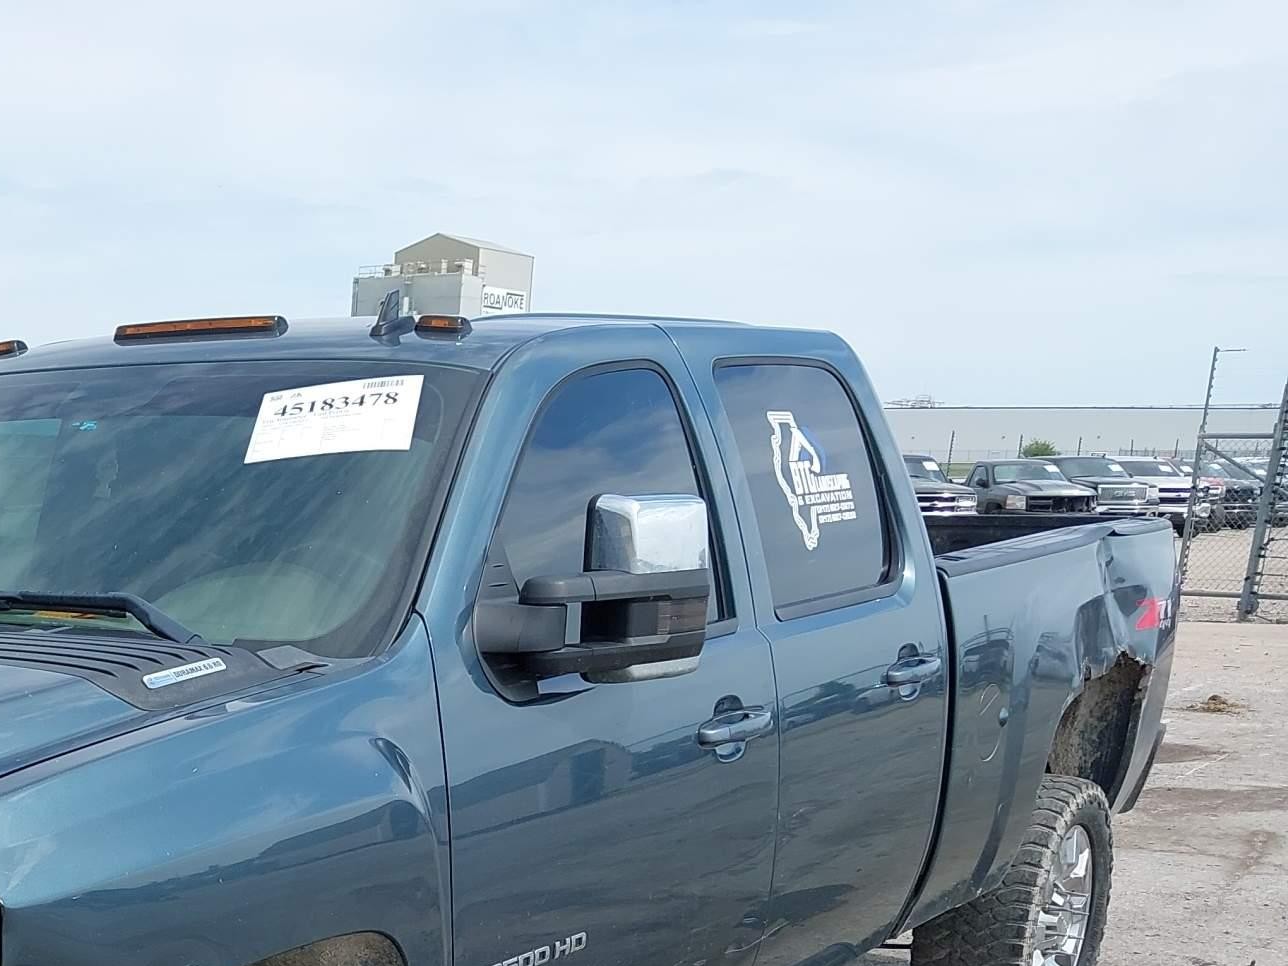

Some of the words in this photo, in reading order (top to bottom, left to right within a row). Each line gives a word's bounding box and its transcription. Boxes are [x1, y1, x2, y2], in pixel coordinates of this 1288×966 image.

[484, 292, 524, 310] ROANOKE
[274, 391, 399, 417] 45183478
[806, 490, 853, 505] EXCAVATION
[553, 931, 587, 960] HD
